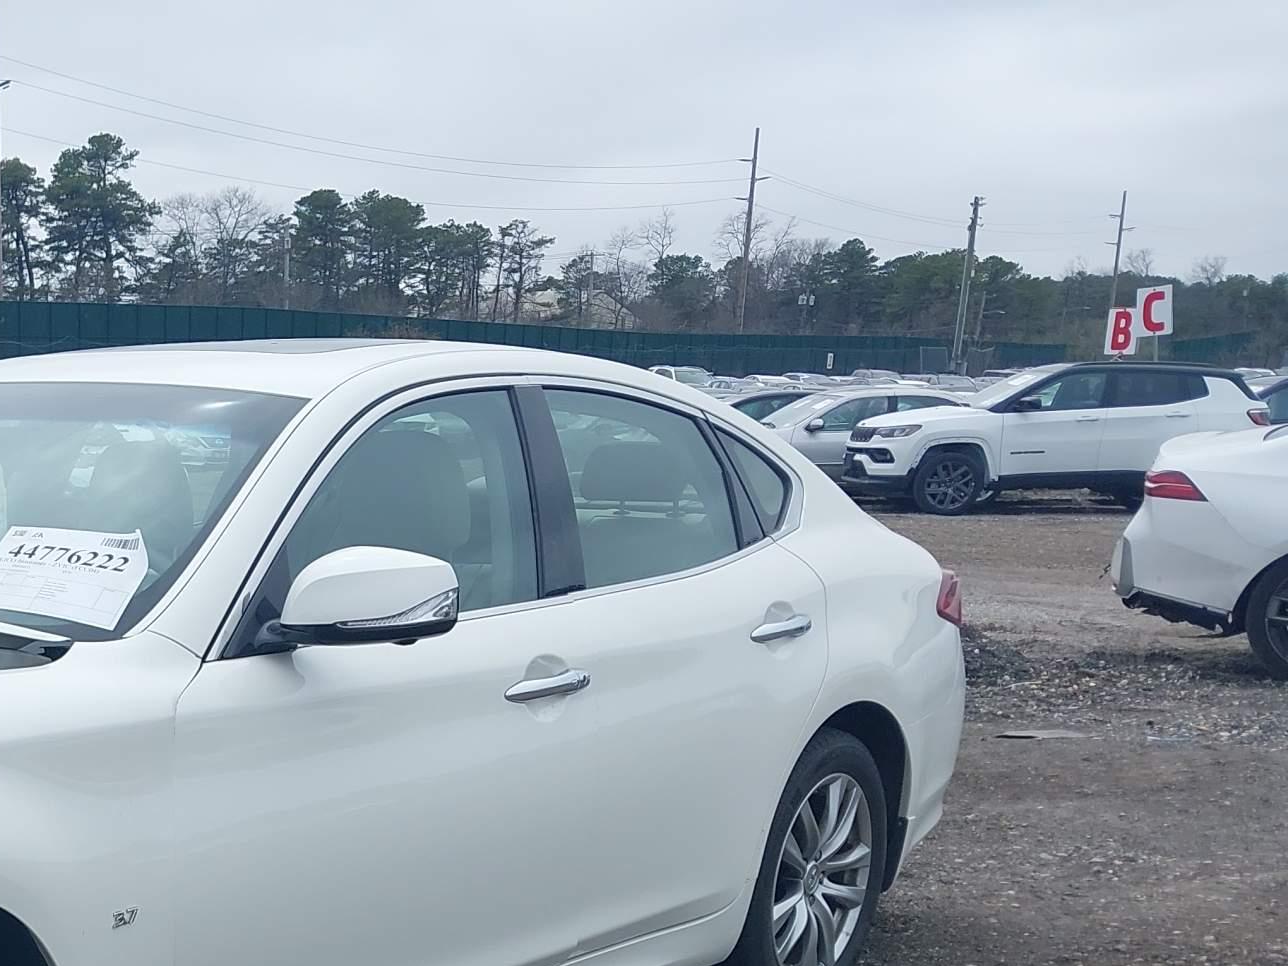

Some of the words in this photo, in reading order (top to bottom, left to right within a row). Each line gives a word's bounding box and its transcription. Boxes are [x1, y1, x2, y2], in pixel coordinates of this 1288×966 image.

[1110, 310, 1133, 351] B
[1142, 290, 1165, 332] C
[7, 543, 130, 573] 44776222
